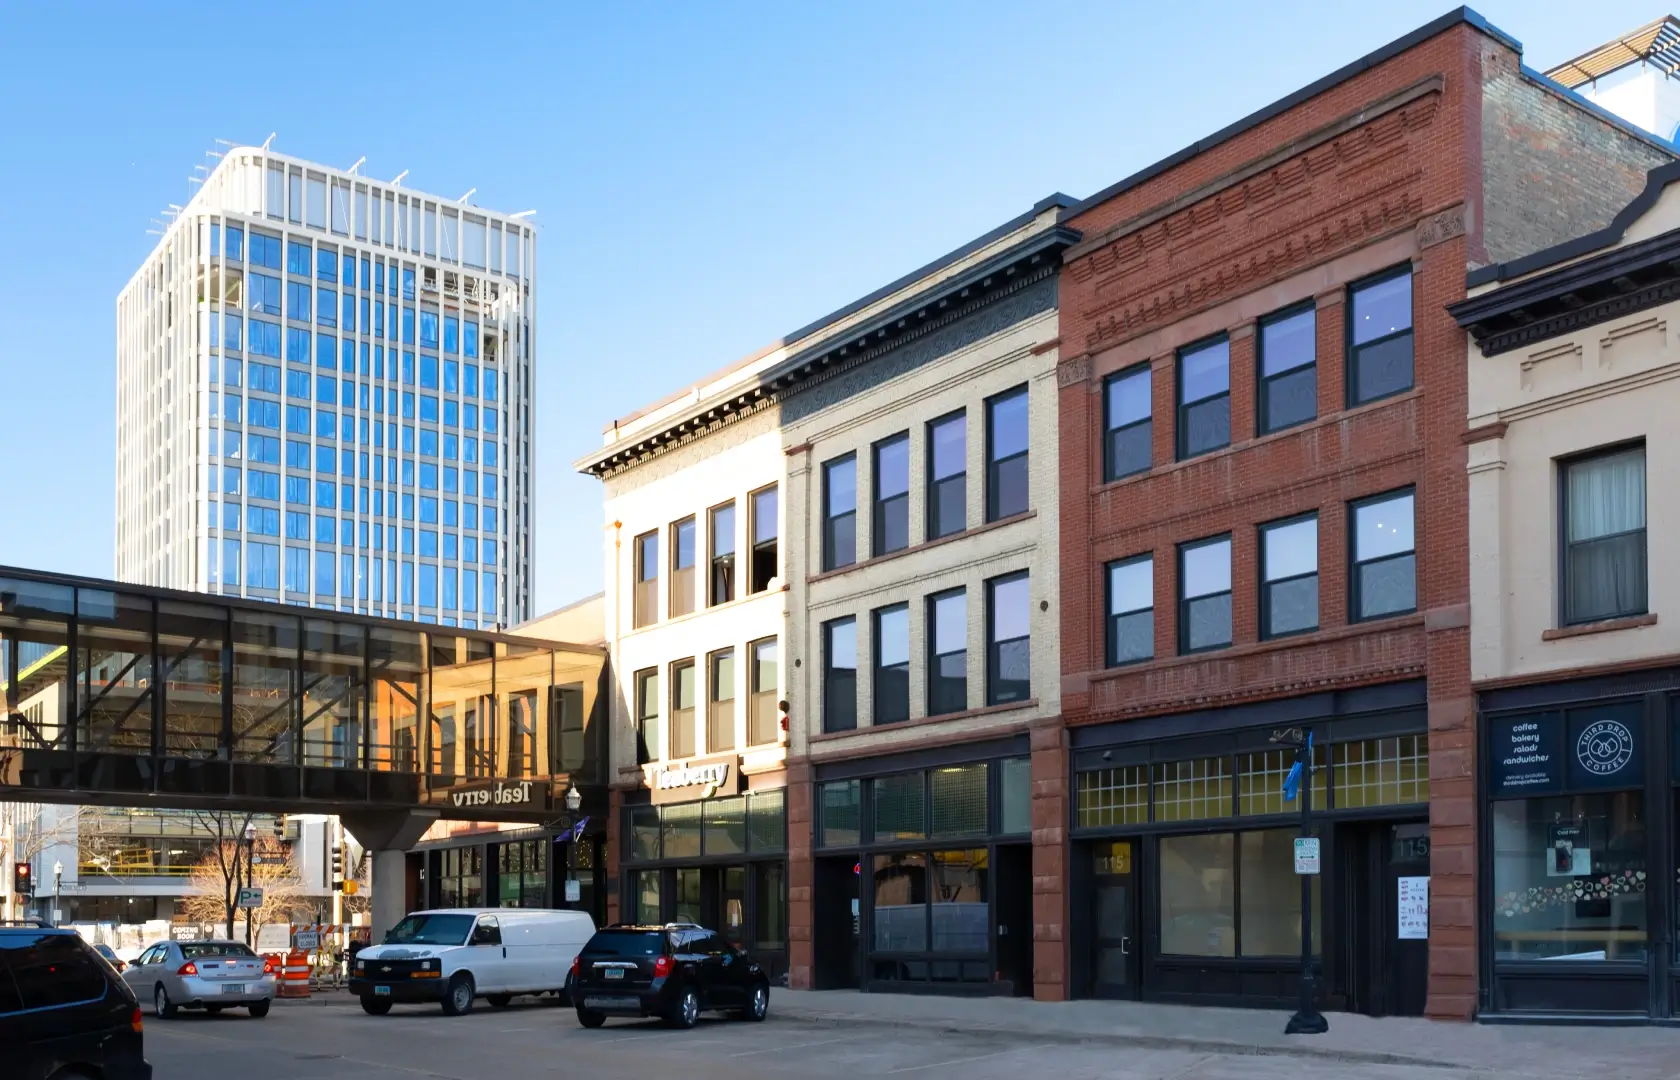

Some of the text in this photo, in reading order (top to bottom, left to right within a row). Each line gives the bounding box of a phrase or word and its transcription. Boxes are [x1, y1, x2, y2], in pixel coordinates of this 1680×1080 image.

[1512, 723, 1538, 732] coffee
[1511, 734, 1540, 743] bakery
[1581, 724, 1628, 745] THIRD DROP
[1513, 744, 1538, 754] salads
[1503, 754, 1549, 765] sandwiches
[1586, 757, 1625, 772] COFFEE
[652, 762, 729, 798] Teaberry
[1103, 855, 1124, 871] 115
[240, 891, 251, 904] P
[172, 926, 199, 934] COMING
